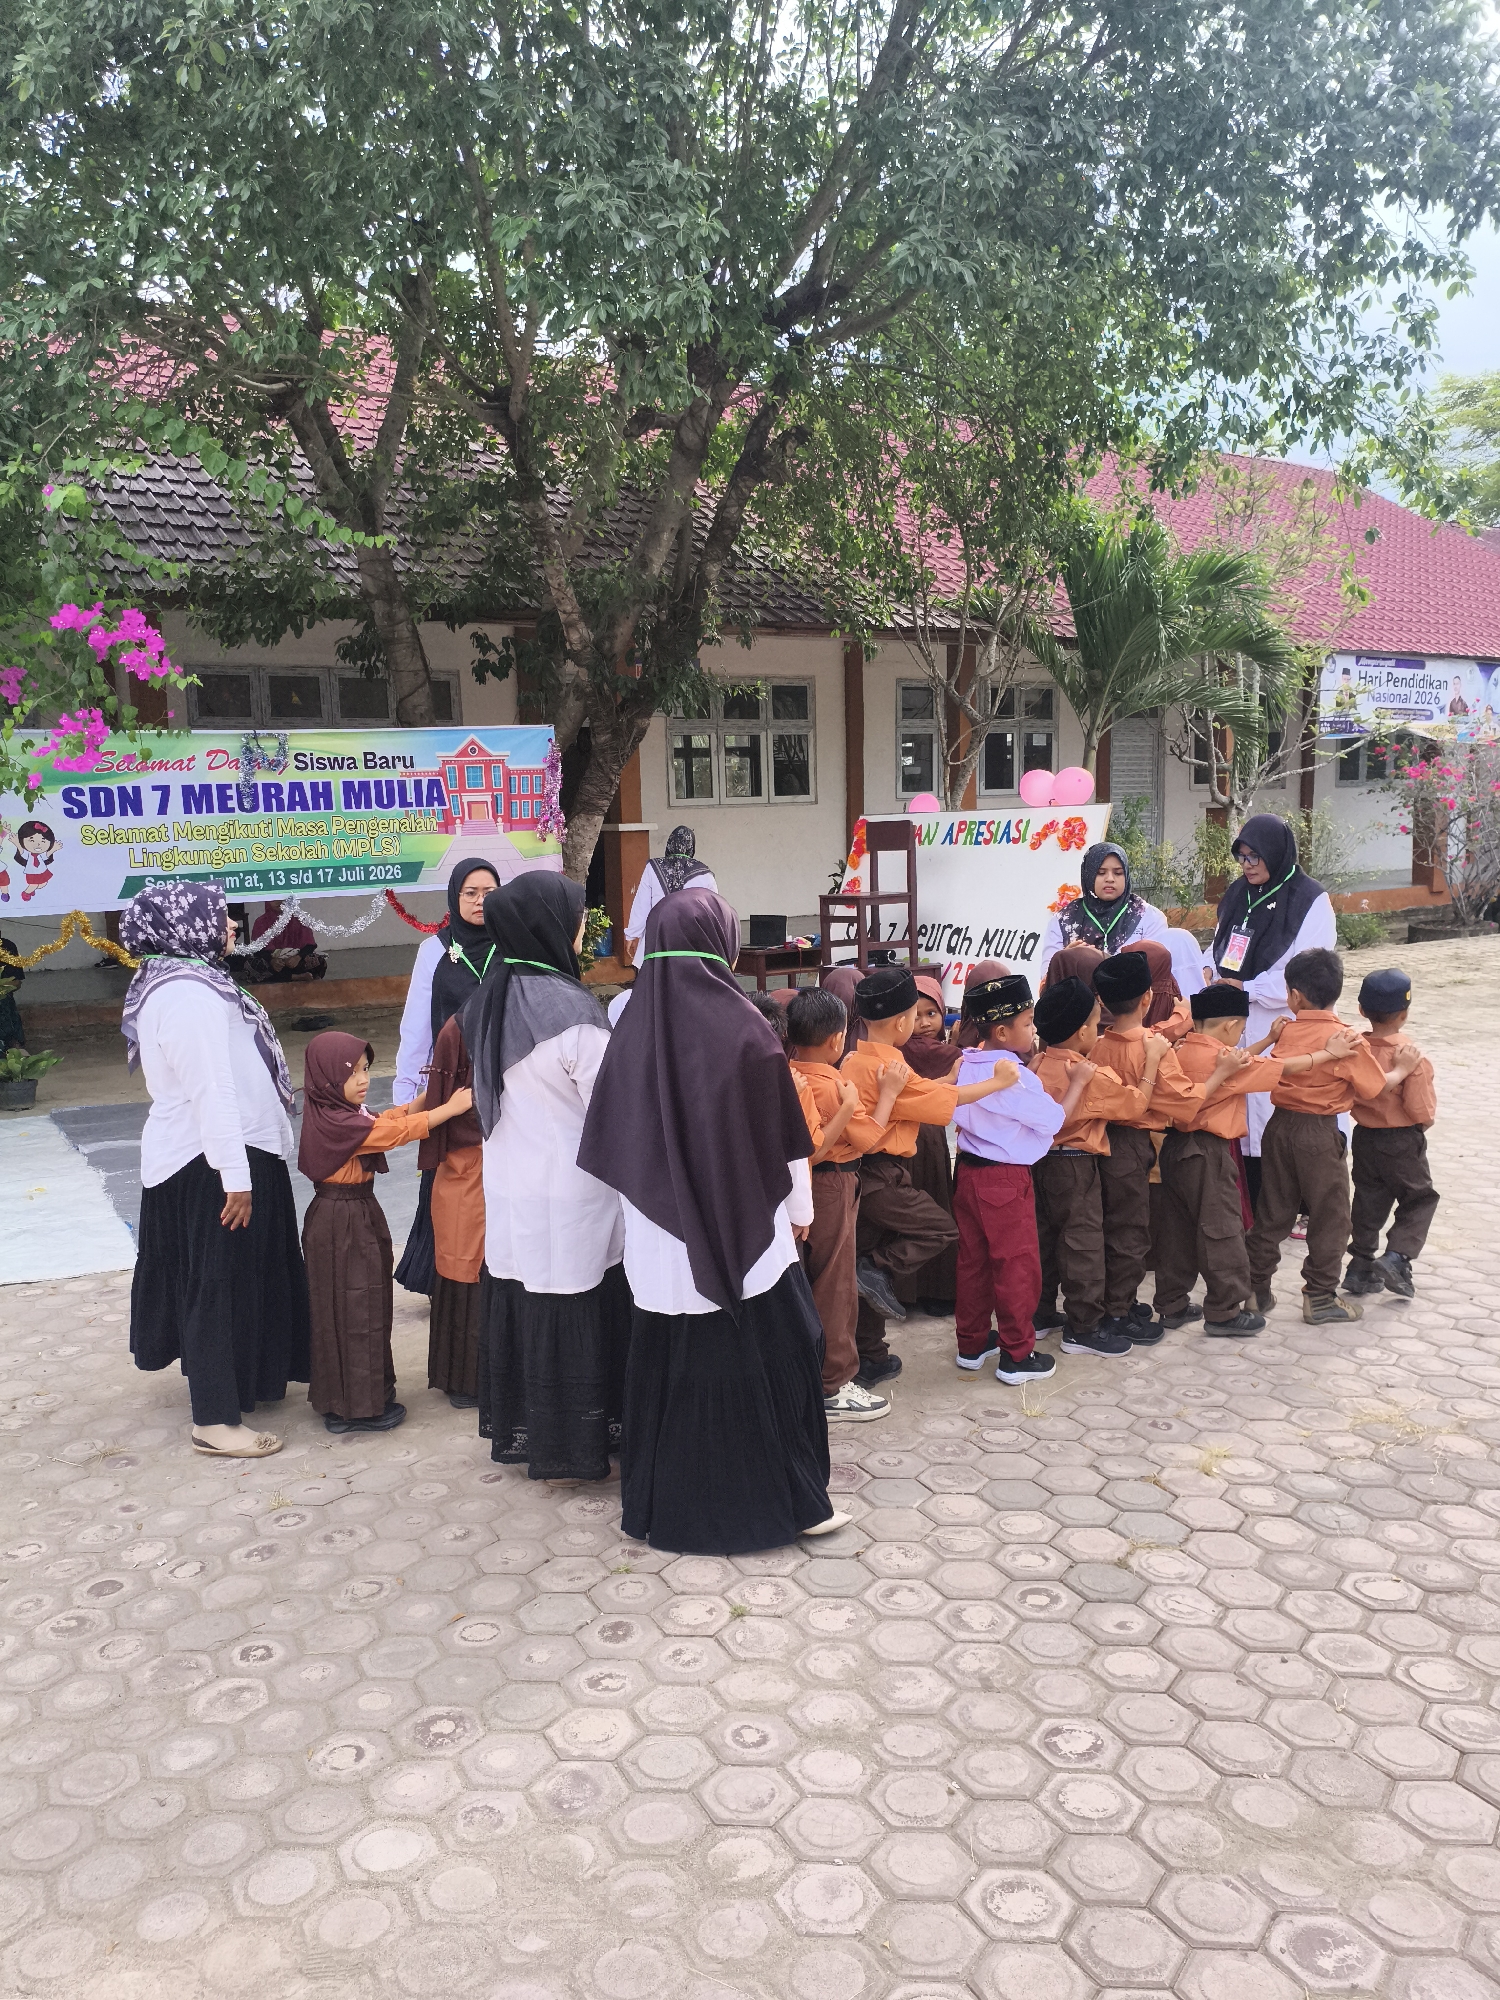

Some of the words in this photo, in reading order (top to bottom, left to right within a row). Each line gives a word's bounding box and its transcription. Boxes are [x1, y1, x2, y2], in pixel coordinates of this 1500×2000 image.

[1359, 670, 1382, 687] Hari
[1386, 671, 1448, 690] Pendidikan
[1367, 689, 1412, 704] Nasional
[1414, 690, 1441, 705] 2026
[293, 752, 359, 772] Siswa
[362, 751, 415, 771] Baru
[61, 785, 144, 819] SDN
[152, 785, 171, 816] 7
[181, 780, 334, 815] MEURAH
[342, 778, 448, 810] MULIA
[81, 824, 170, 845] Selamat
[173, 819, 273, 844] Mengikuti
[277, 818, 329, 838] Masa
[332, 814, 438, 838] Pengenalan
[940, 818, 1031, 846] APRESIASI
[129, 846, 248, 871] Lingkungan
[251, 840, 329, 862] Sekolah
[333, 836, 400, 859] (MPLS)
[269, 870, 285, 886] 13
[290, 869, 313, 885] s/d
[317, 868, 334, 883] 17
[338, 867, 365, 882] Juli
[369, 864, 402, 880] 2026
